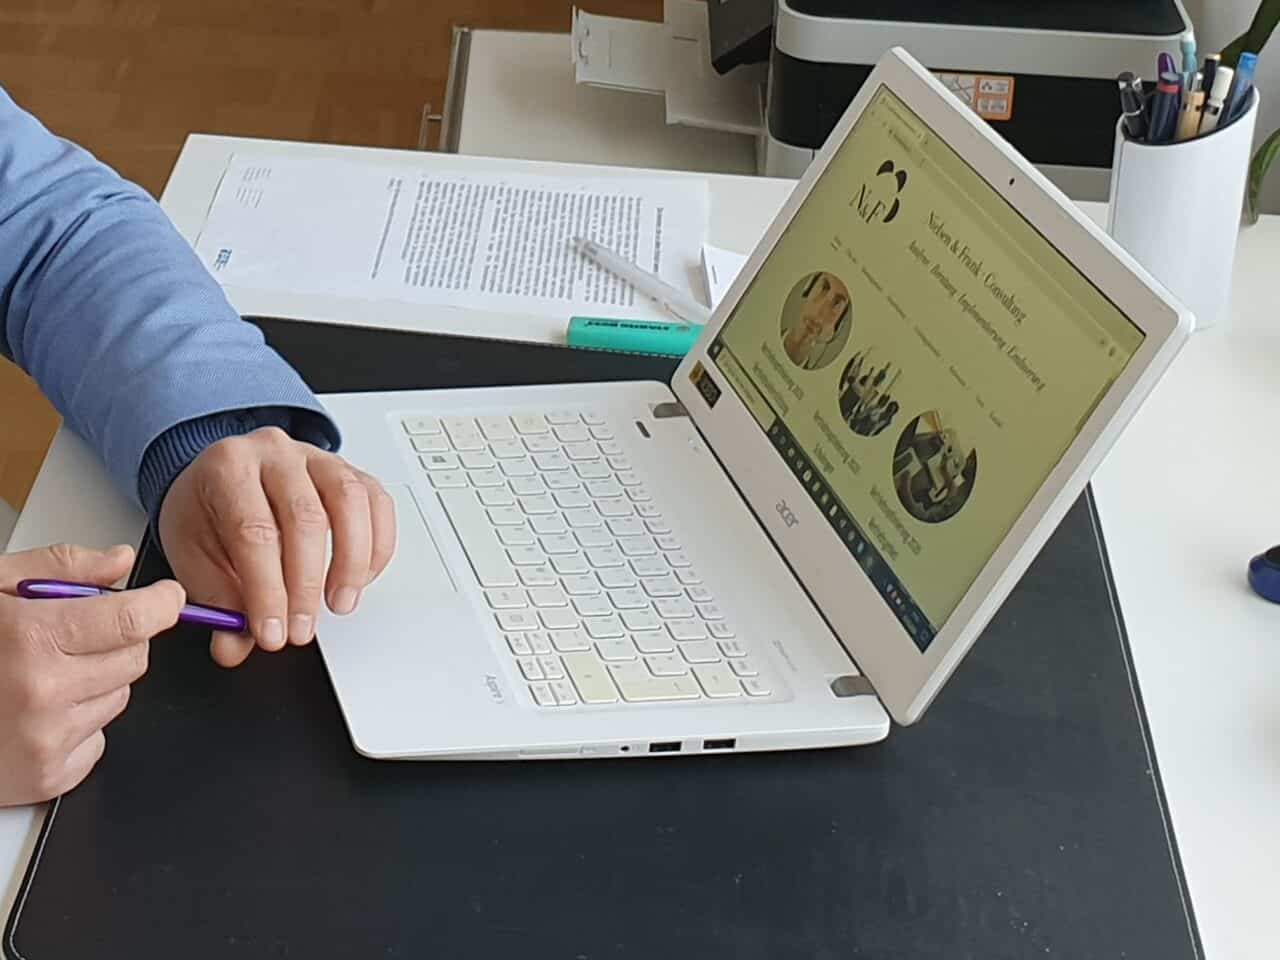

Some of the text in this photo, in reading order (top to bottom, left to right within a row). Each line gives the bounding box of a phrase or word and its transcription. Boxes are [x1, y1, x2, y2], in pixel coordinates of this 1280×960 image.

[958, 245, 984, 277] Frank
[983, 272, 1027, 326] Consulting
[776, 500, 800, 528] acer
